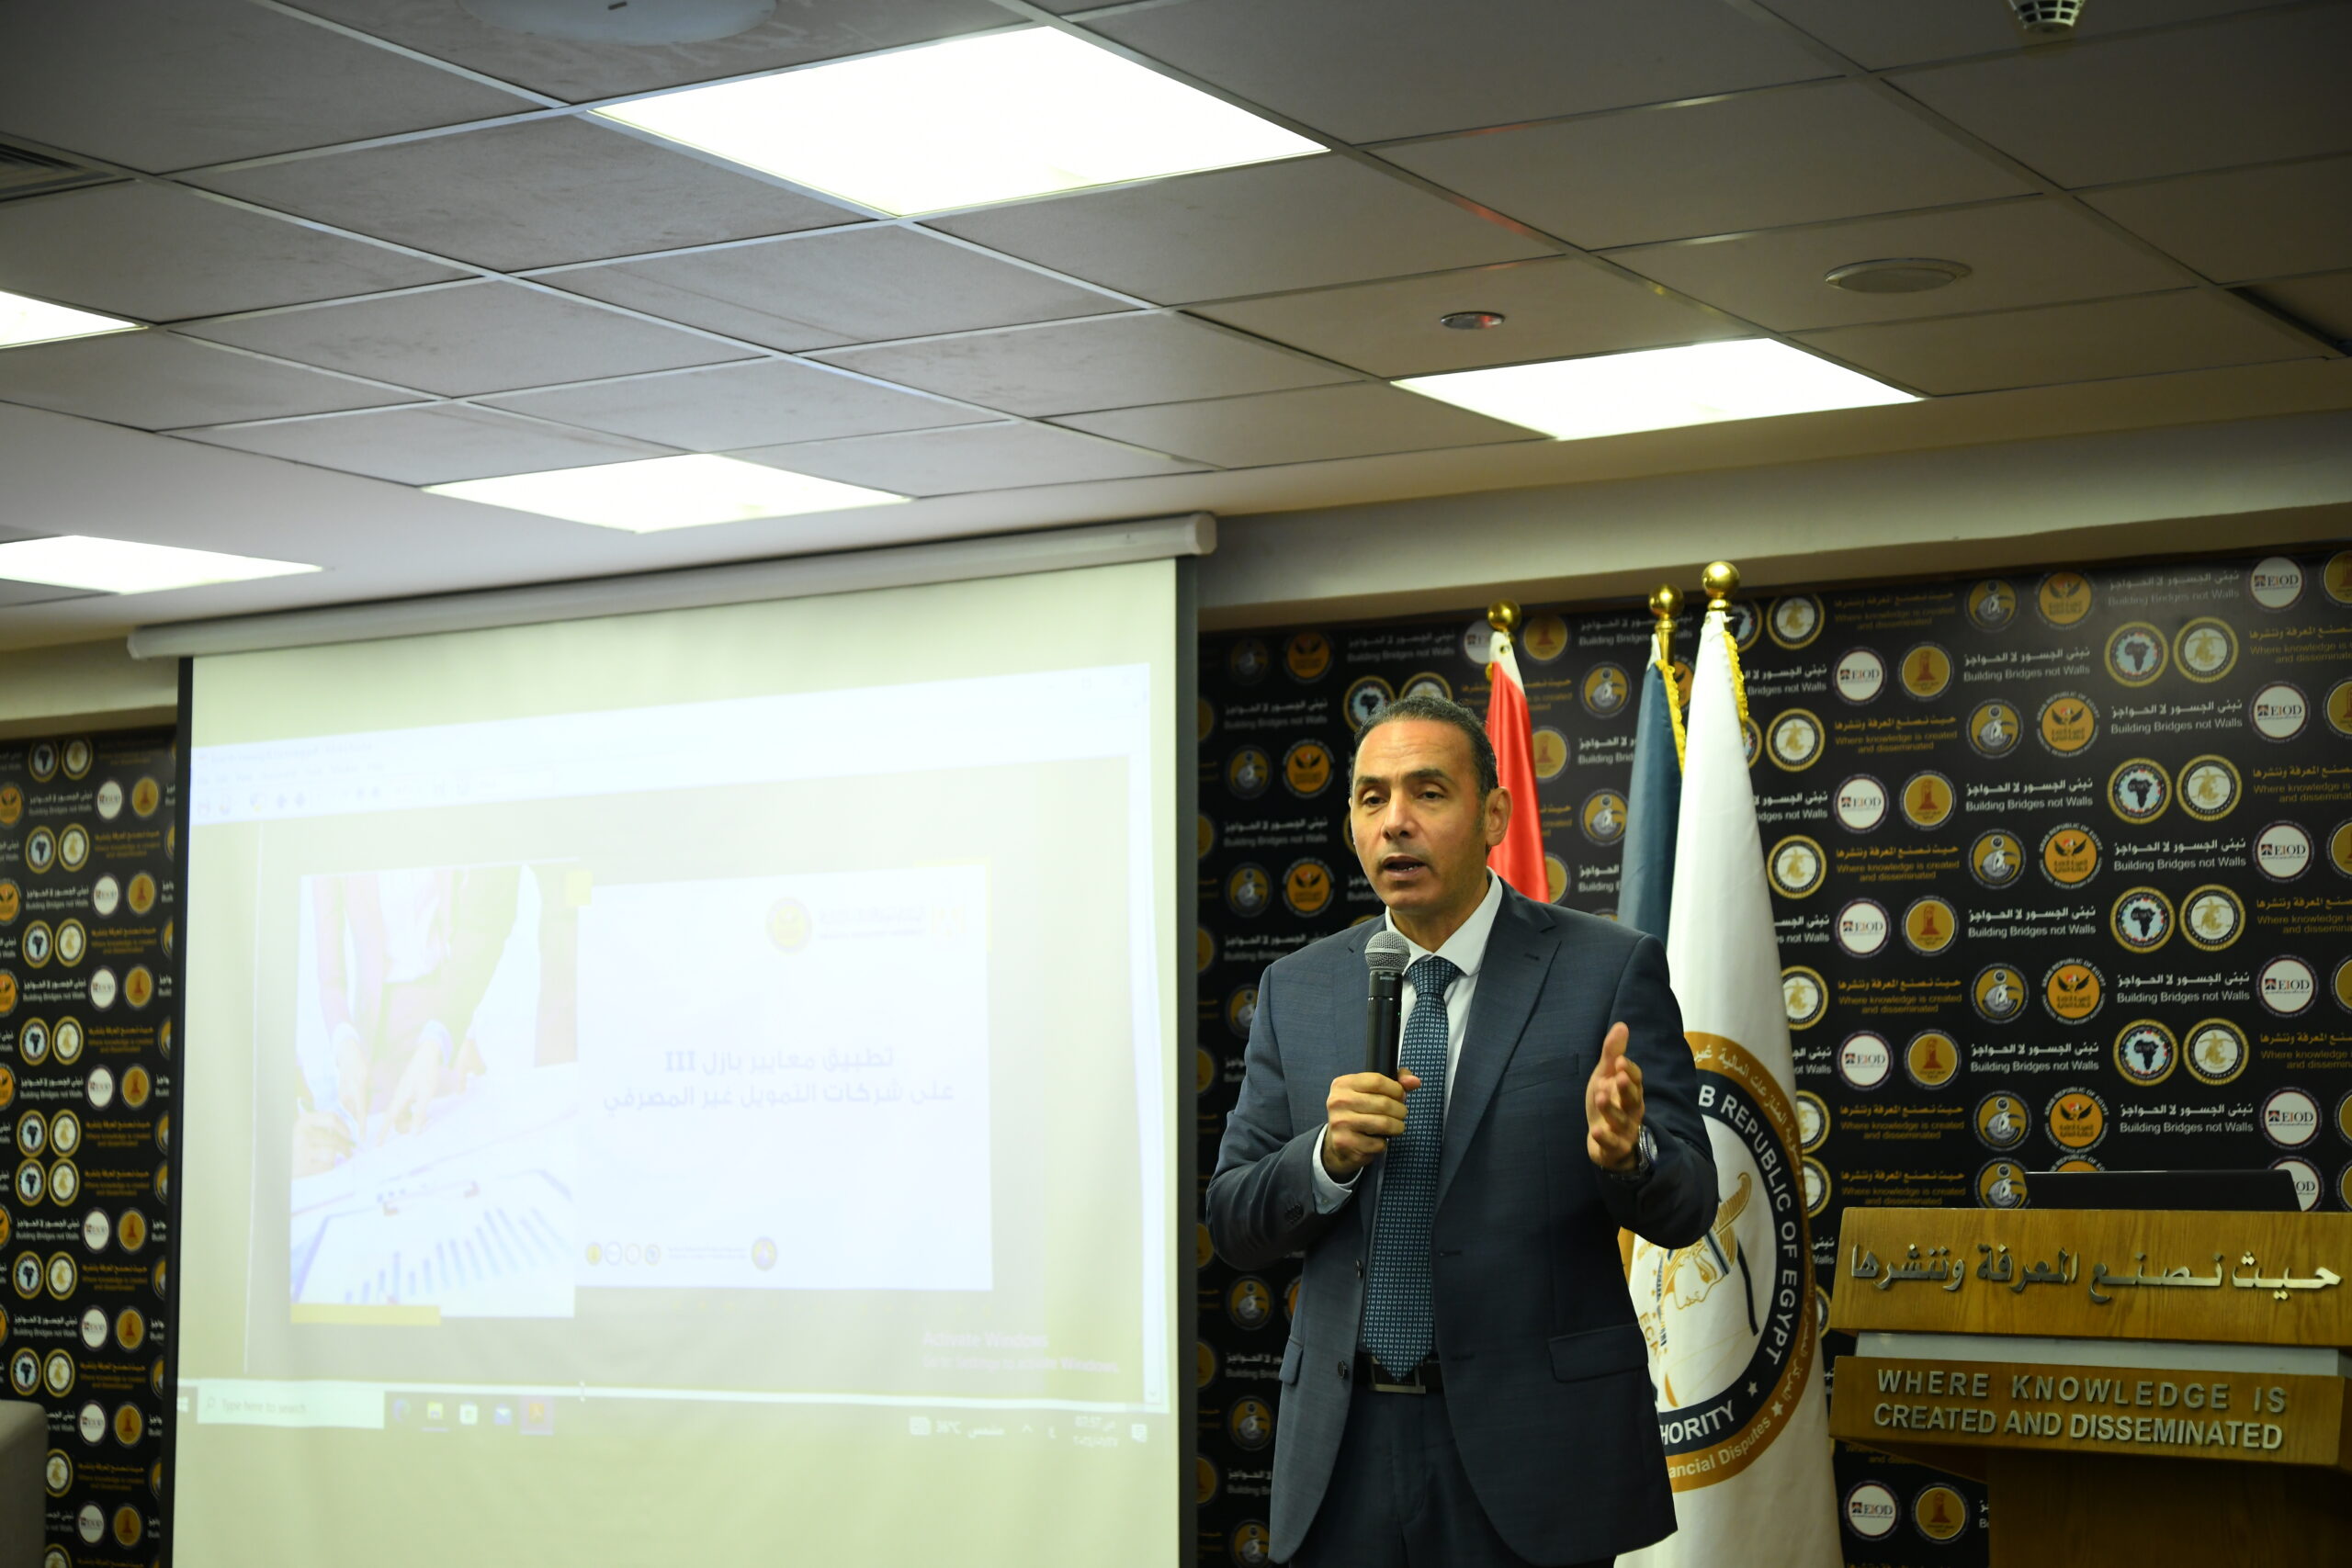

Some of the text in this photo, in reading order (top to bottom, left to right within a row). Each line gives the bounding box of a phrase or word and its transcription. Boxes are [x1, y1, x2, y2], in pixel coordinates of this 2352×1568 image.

[1962, 664, 2090, 682] Building Bridges not Walls
[1747, 682, 1826, 697] Bridges not Walls
[2110, 717, 2242, 734] Building Bridges not Walls
[1965, 795, 2093, 812] Building Bridges not Walls
[2113, 856, 2245, 872] Building Bridges not Walls
[1967, 923, 2096, 938] Building Bridges not Walls
[2116, 989, 2249, 1004] Building Bridges not Walls
[663, 1045, 894, 1076] تطبيق معايير بازل III
[1970, 1060, 2098, 1073] Building Bridges not Walls
[701, 1085, 734, 1111] غير
[740, 1082, 816, 1110] التمويل
[822, 1077, 903, 1105] شركات
[2120, 1121, 2253, 1134] Building Bridges not Walls
[2293, 1181, 2315, 1191] OD
[1720, 1093, 1798, 1366] REPUBLIC OF EGYPT
[1850, 1243, 2343, 1303] حيث نصنع المعرفة وننشرها
[922, 1331, 1048, 1348] Activate Windows
[1877, 1369, 2288, 1414] WHERE KNOWLEDGE IS
[1660, 1399, 1735, 1447] HORITY
[1873, 1402, 2284, 1451] CREATED AND DISSEMINATED
[1668, 1417, 1771, 1478] ancial Disputes
